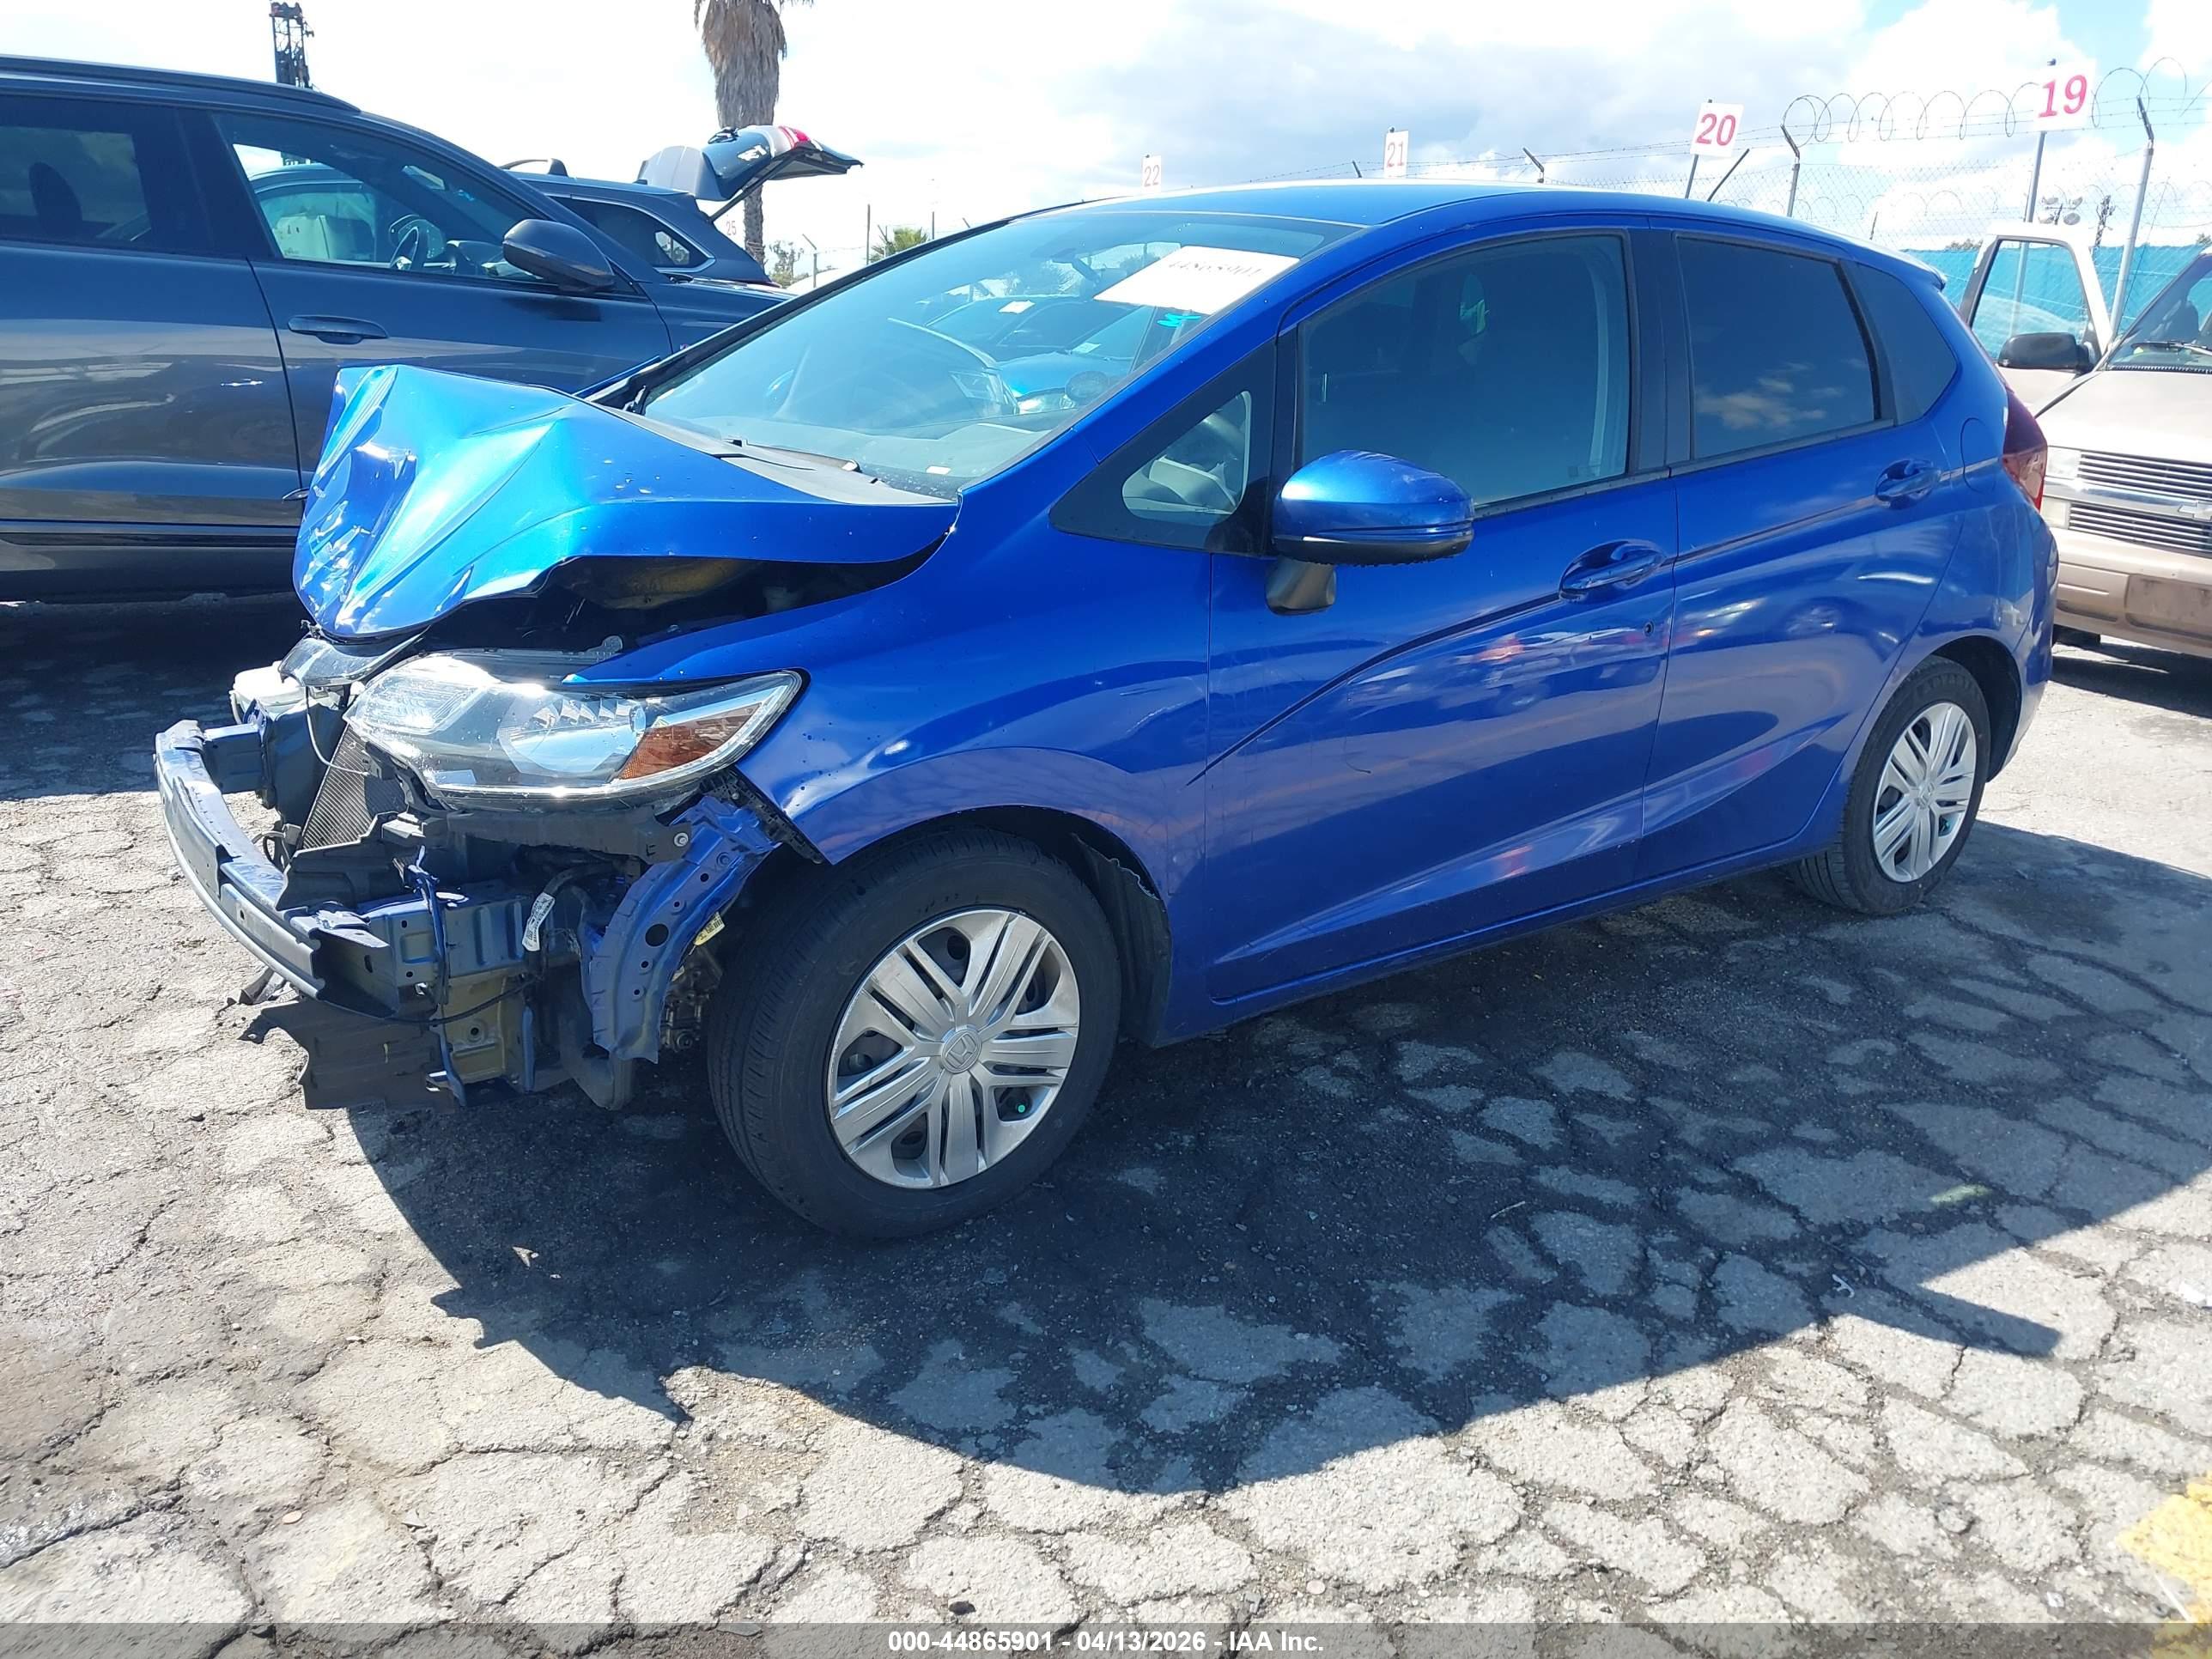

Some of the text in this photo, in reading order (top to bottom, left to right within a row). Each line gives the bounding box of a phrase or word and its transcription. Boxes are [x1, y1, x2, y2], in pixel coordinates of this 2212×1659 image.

[2039, 75, 2087, 118] 19
[1696, 113, 1736, 146] 20
[1387, 141, 1405, 167] 21
[1144, 165, 1159, 187] 22
[726, 221, 737, 236] 25
